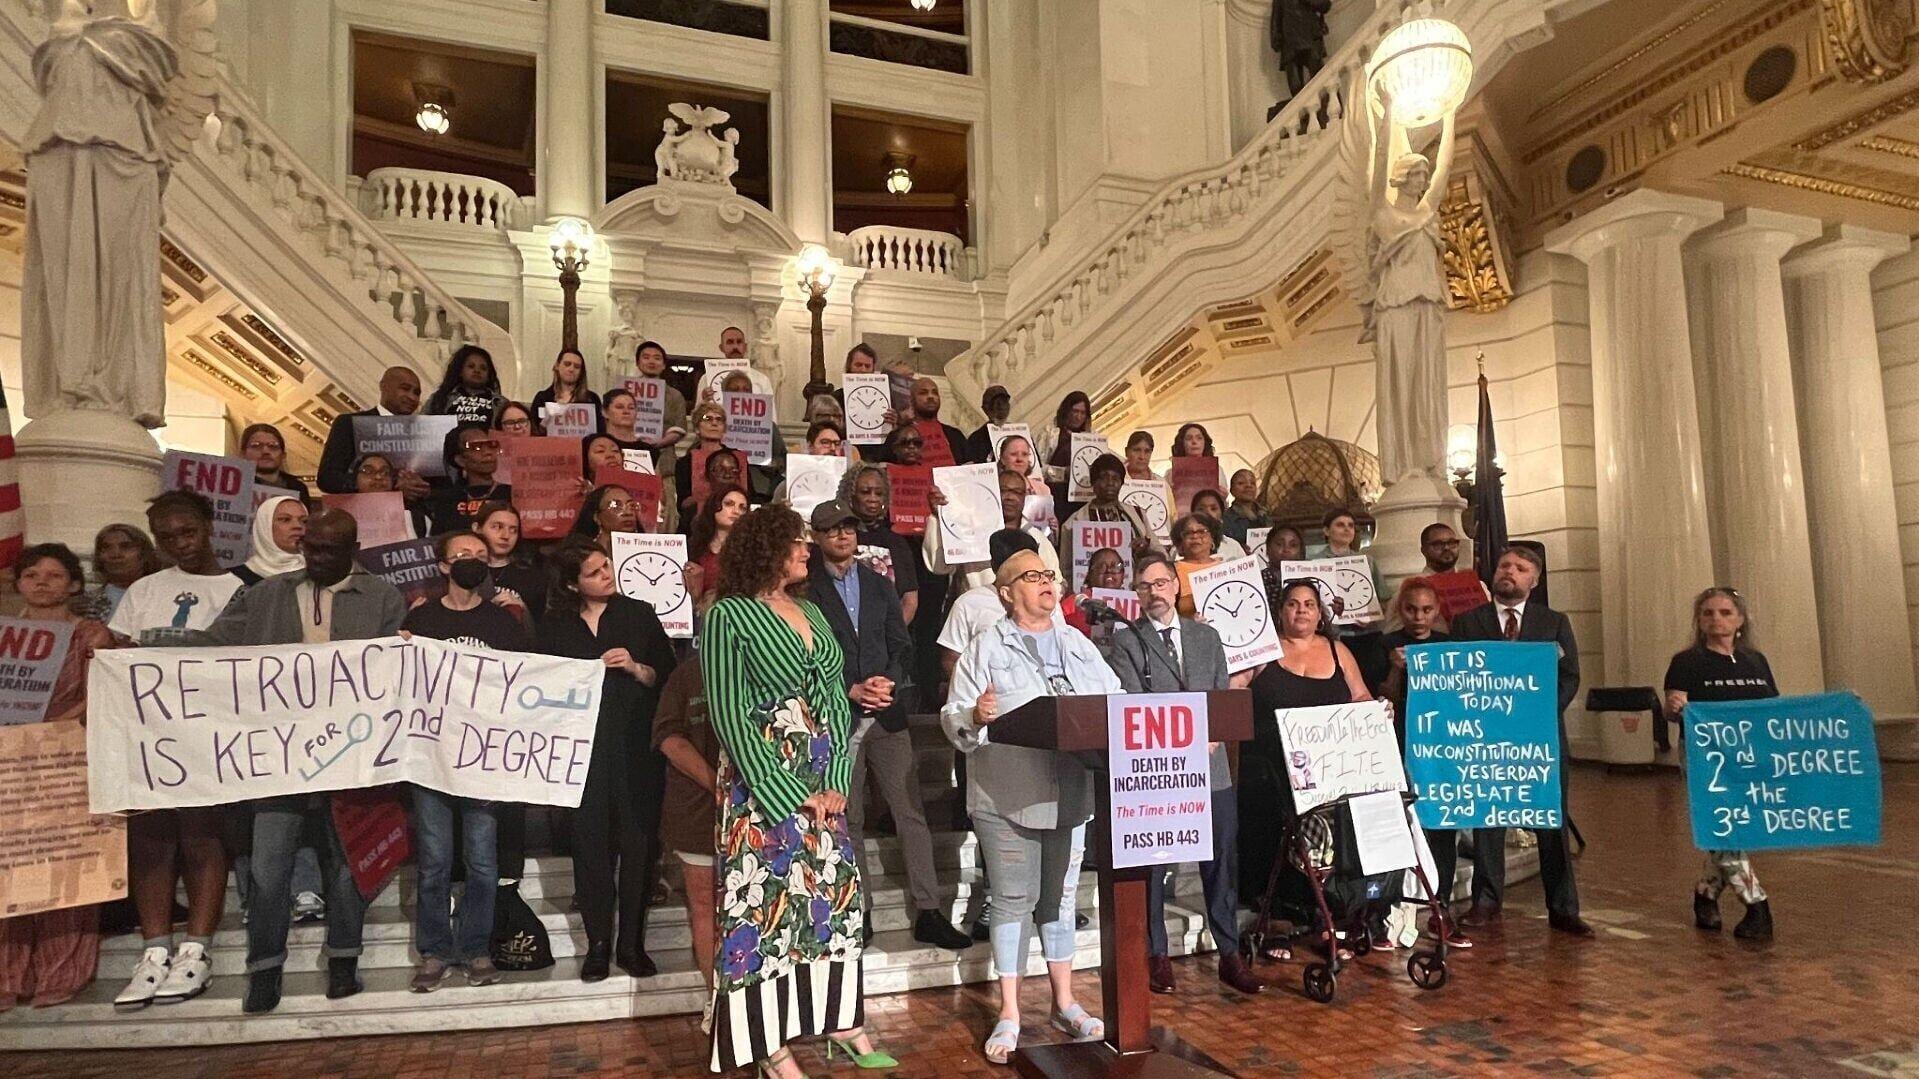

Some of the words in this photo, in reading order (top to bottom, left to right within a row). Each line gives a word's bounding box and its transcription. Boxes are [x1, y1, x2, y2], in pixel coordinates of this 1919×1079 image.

[731, 397, 767, 418] END
[176, 458, 242, 496] END
[617, 537, 631, 545] The
[634, 538, 652, 546] Time
[1082, 527, 1123, 548] END
[1193, 576, 1208, 585] The
[1209, 570, 1228, 579] Time
[1229, 567, 1236, 575] is
[1237, 560, 1255, 571] NOW
[0, 626, 56, 661] ND
[1413, 652, 1429, 672] IF
[1440, 651, 1460, 671] IT
[1467, 650, 1486, 669] IS
[129, 644, 523, 725] RETROACTIVITY
[1410, 670, 1540, 692] UNCONSTITUTIONAL
[1123, 705, 1194, 750] END
[1417, 711, 1439, 734] IT
[1447, 719, 1485, 739] WAS
[1694, 720, 1753, 748] STOP
[1767, 717, 1849, 742] GIVING
[140, 737, 187, 791] IS
[214, 723, 296, 783] KEY
[304, 721, 342, 758] FOR
[453, 722, 591, 786] DEGREE
[1412, 742, 1556, 763] UNCONSTITUTIONAL
[1132, 757, 1168, 773] DEATH
[1172, 756, 1187, 772] BY
[1457, 764, 1551, 785] YESTERDAY
[1706, 744, 1757, 792] 2nd
[1770, 749, 1864, 778] DEGREE
[1114, 772, 1207, 793] INCARCERATION
[1414, 783, 1533, 803] LEGISLATE
[1116, 806, 1136, 819] The
[1138, 804, 1164, 817] Time
[1167, 803, 1177, 815] is
[1179, 801, 1206, 814] NOW
[1439, 799, 1476, 827] 2nd
[1713, 804, 1750, 837] 3rd
[1763, 806, 1853, 834] DEGREE
[1124, 832, 1154, 850] PASS
[1157, 831, 1174, 847] HB
[1176, 829, 1200, 845] 443
